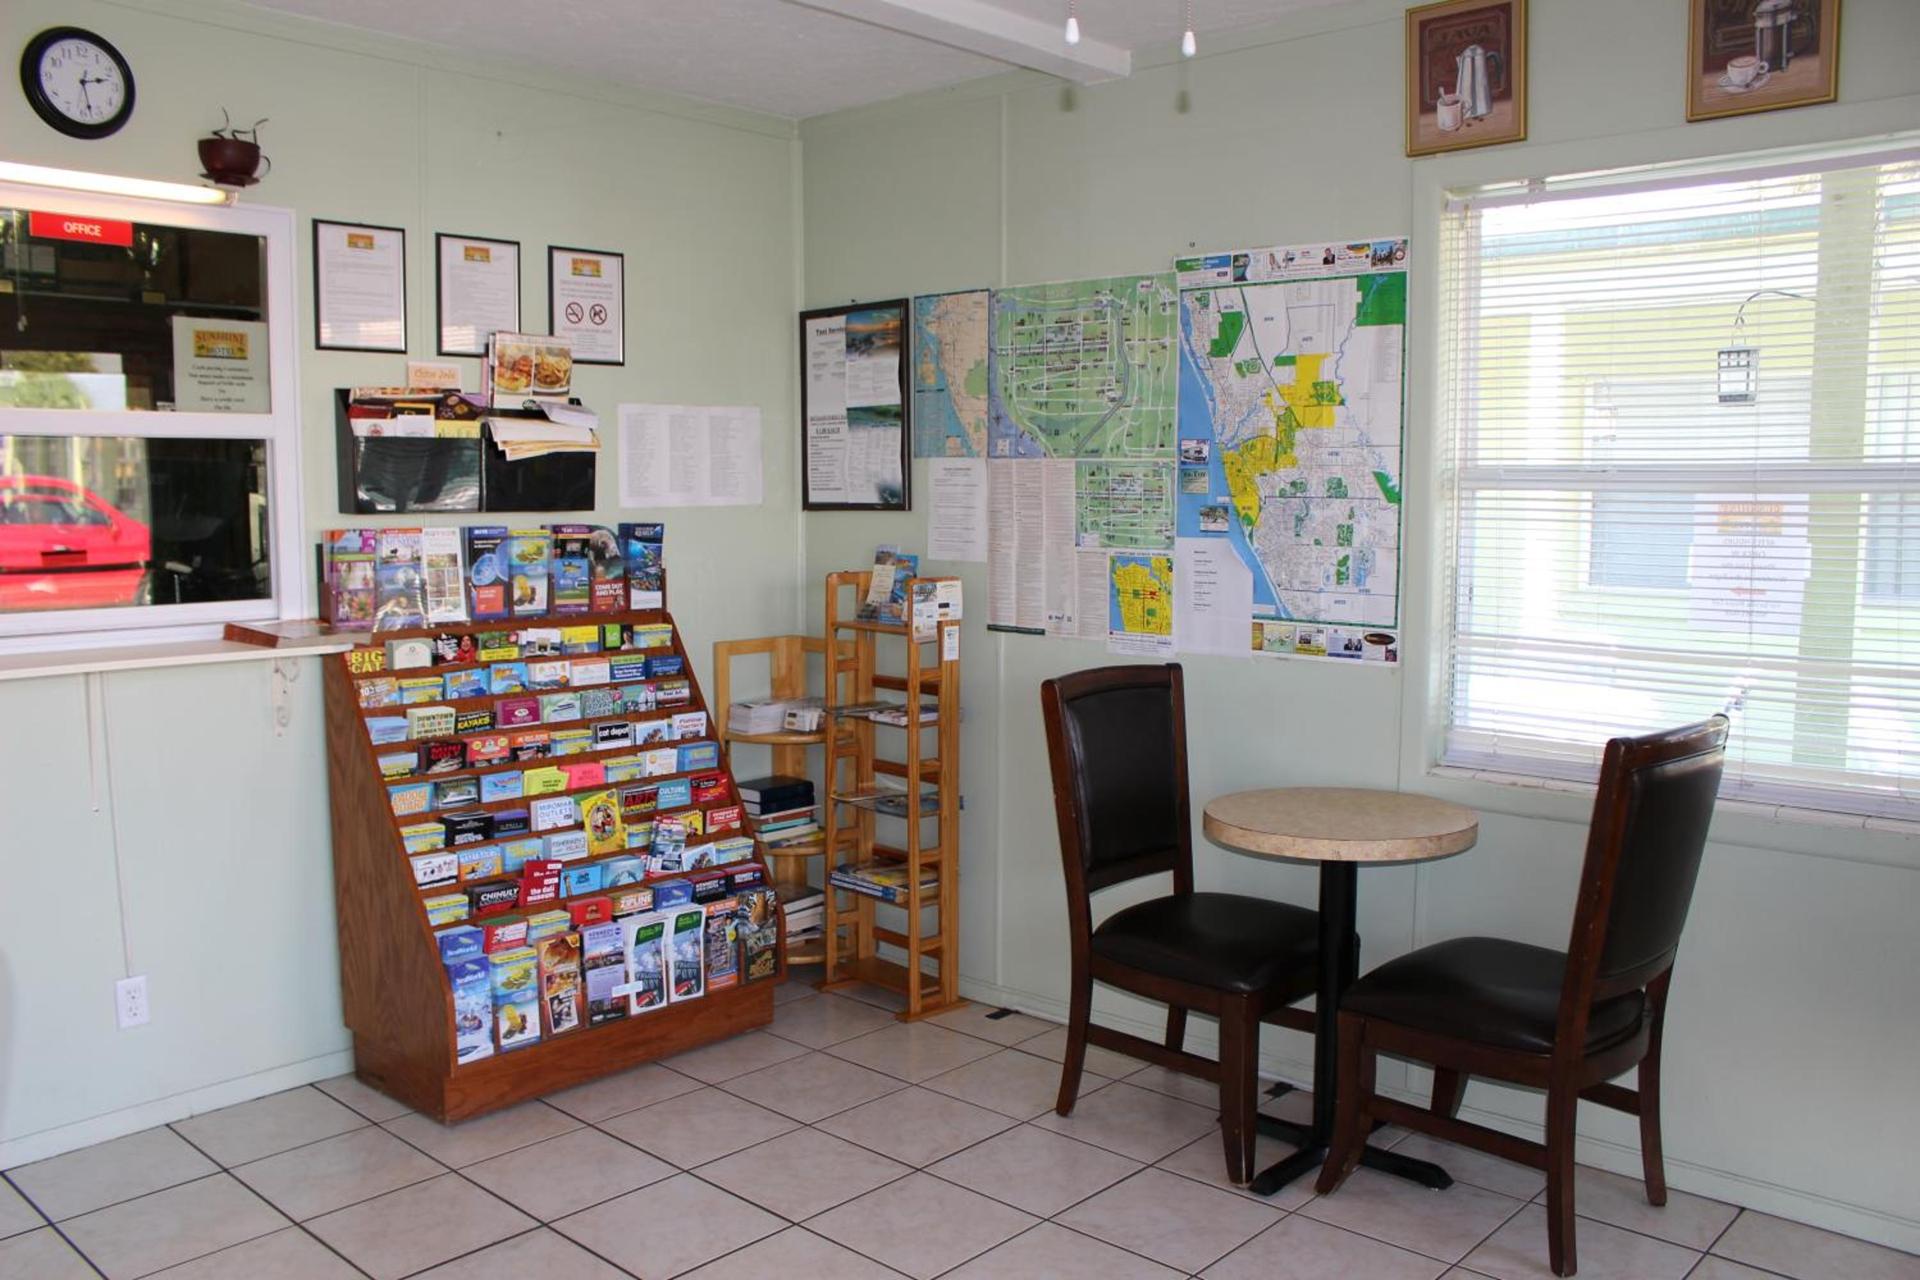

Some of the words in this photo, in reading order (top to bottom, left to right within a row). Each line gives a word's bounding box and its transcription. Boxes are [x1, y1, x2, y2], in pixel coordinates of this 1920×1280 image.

[63, 221, 103, 237] OFFICE
[351, 650, 383, 663] BIG
[352, 662, 383, 674] CAT
[457, 716, 491, 729] KAYAKS
[611, 726, 630, 736] depot
[480, 887, 519, 900] CHIHULY
